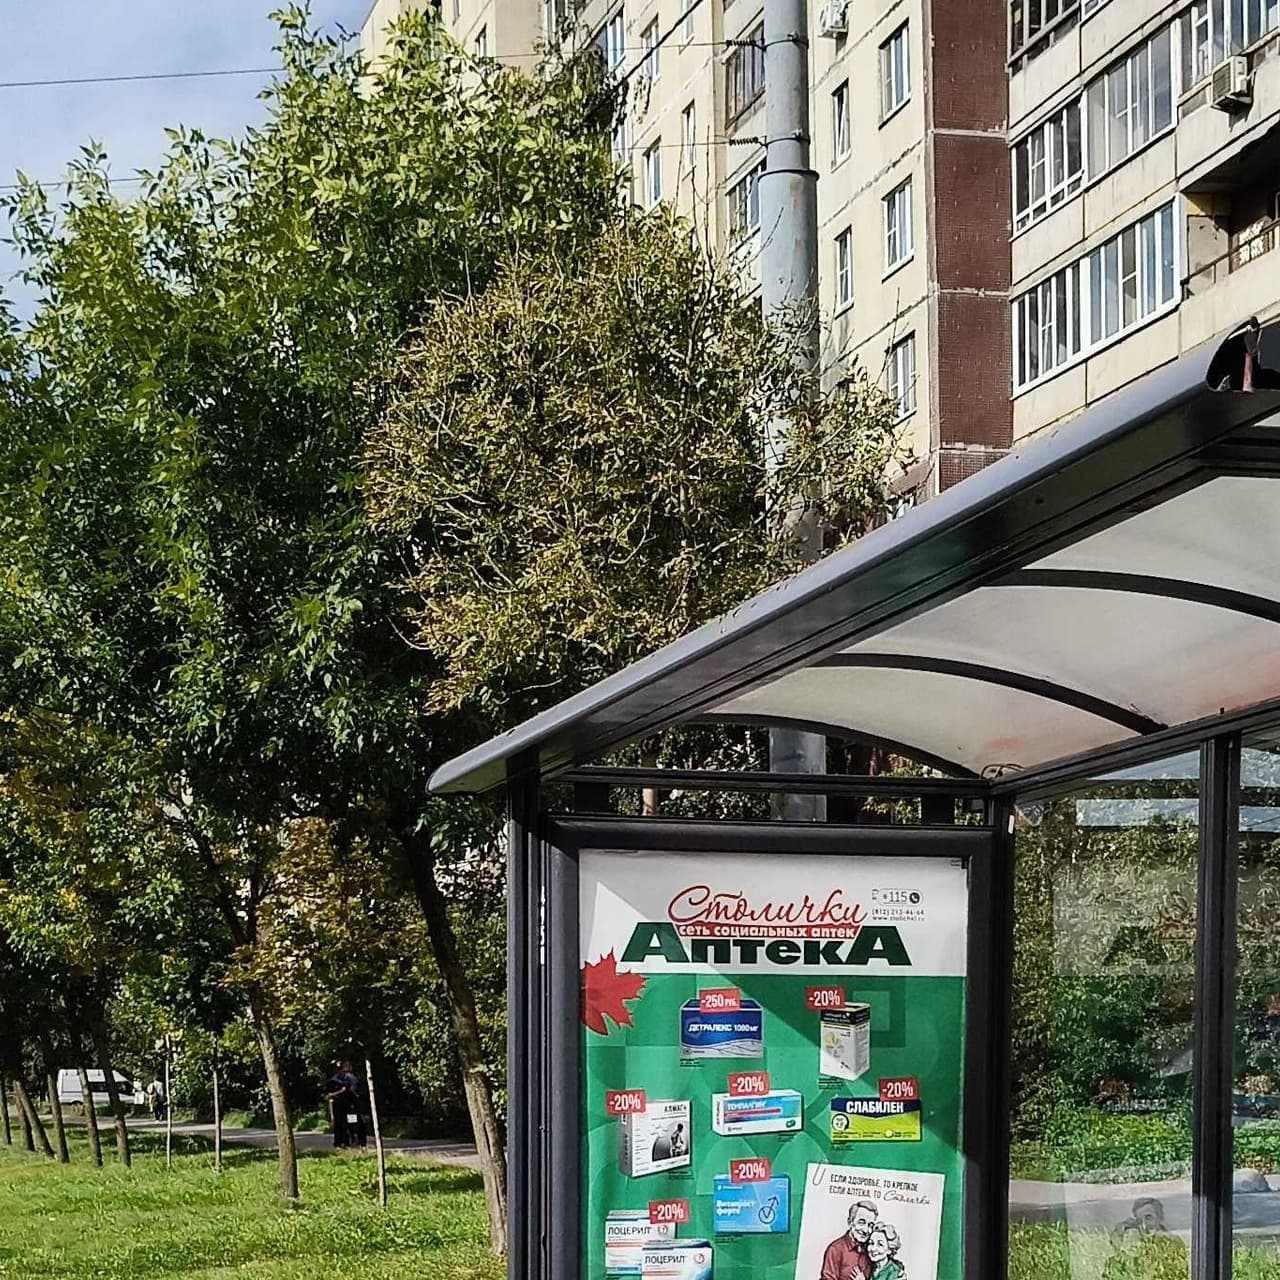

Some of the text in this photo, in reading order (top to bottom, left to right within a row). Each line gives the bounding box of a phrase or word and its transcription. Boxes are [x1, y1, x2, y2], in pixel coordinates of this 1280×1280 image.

[668, 885, 868, 924] Столички
[679, 925, 856, 939] сеть социальных аптек
[701, 994, 724, 1008] -250
[808, 990, 841, 1007] -20%
[732, 1075, 765, 1093] -20%
[882, 1081, 914, 1098] -20%
[609, 1094, 641, 1111] -20%
[845, 1100, 904, 1114] СЛАБИЛЕН
[734, 1162, 766, 1179] -20%
[651, 1203, 685, 1221] -20%
[607, 1226, 651, 1236] ЛОЦЕРИЛ
[644, 1255, 686, 1265] ЛОЦЕРИЛ
